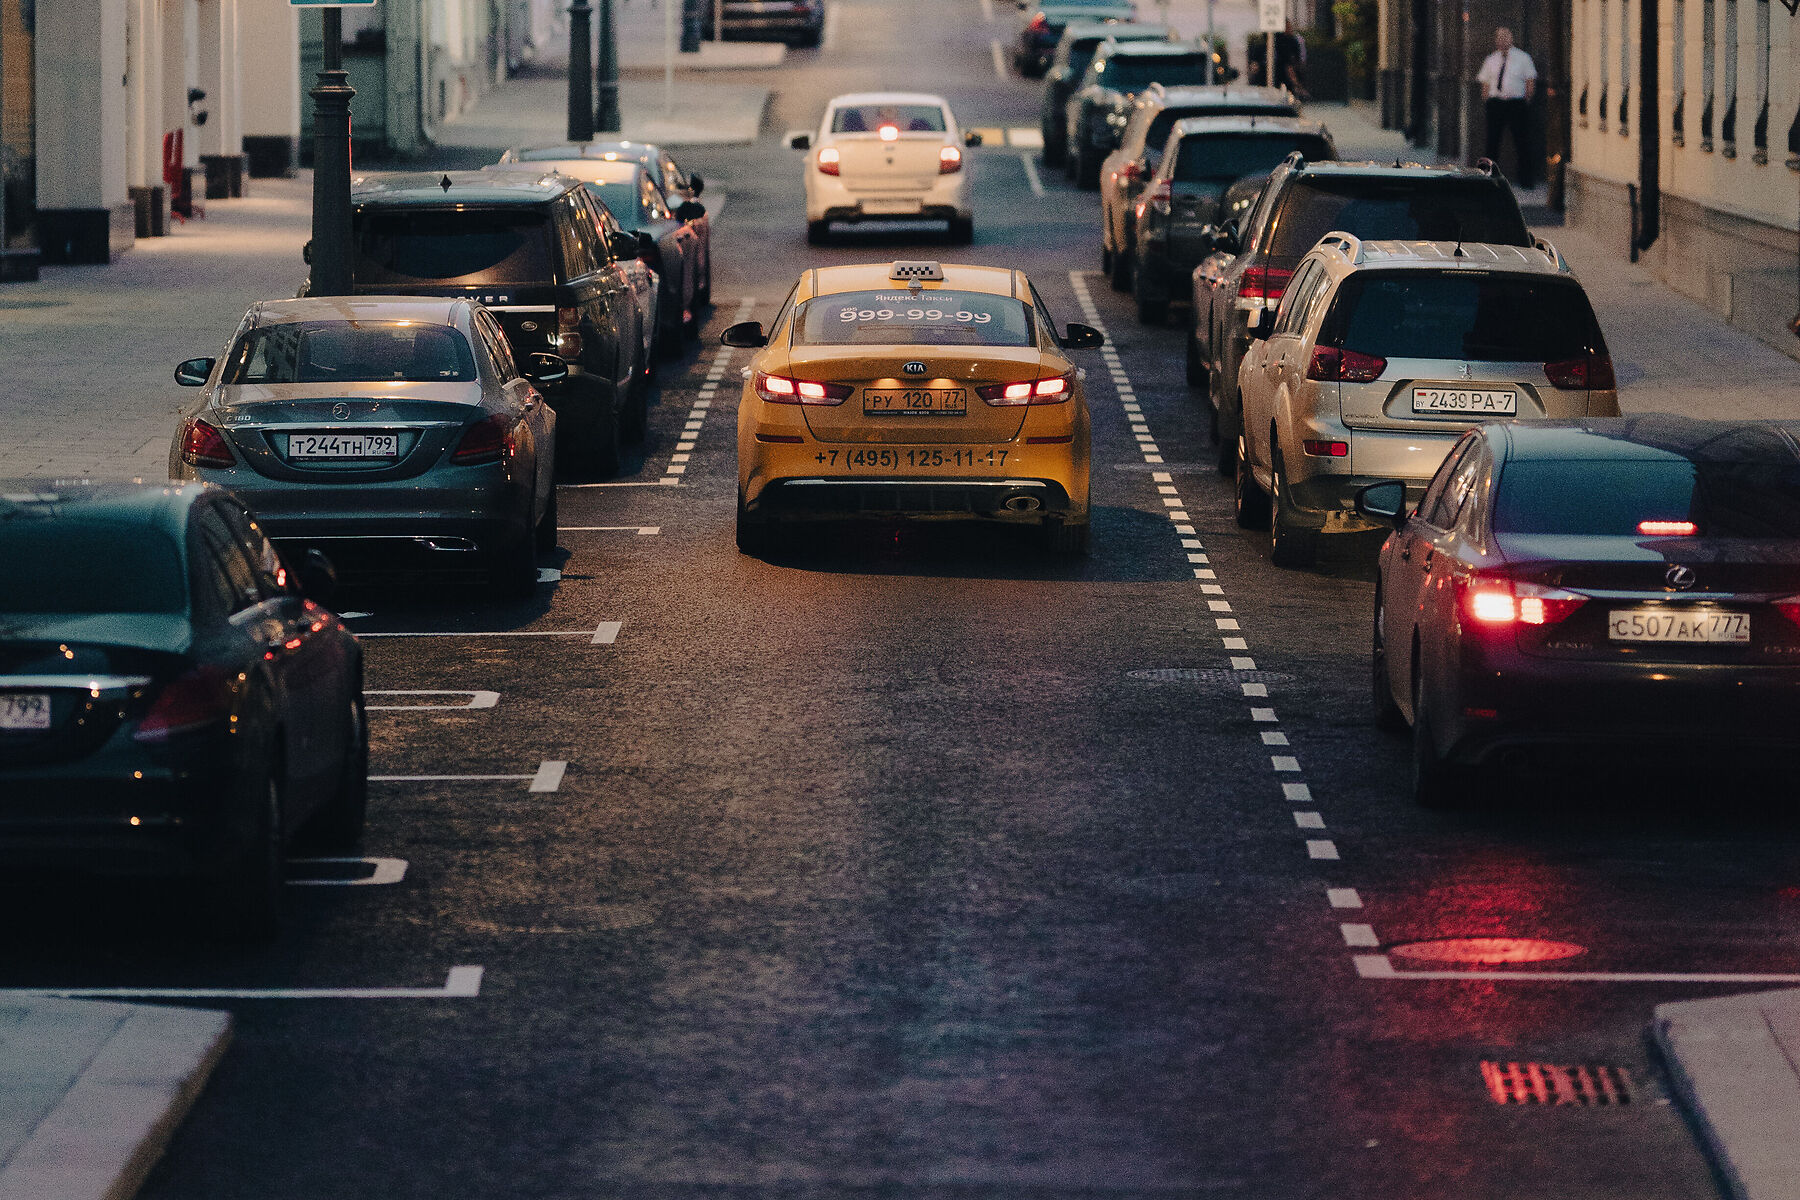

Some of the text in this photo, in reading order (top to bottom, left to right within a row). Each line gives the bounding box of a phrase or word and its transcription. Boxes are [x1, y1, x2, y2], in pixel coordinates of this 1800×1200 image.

[875, 294, 953, 303] Яндекс Такси
[839, 308, 992, 324] 999-99-99
[906, 364, 924, 373] KIA
[902, 391, 933, 409] 120
[943, 391, 960, 404] 77
[1415, 400, 1425, 408] BY
[1429, 392, 1468, 409] 2439
[366, 436, 393, 450] 799
[814, 450, 1010, 471] +7 (495) 125-11-17
[1710, 615, 1744, 633] 777
[2, 697, 43, 718] 799
